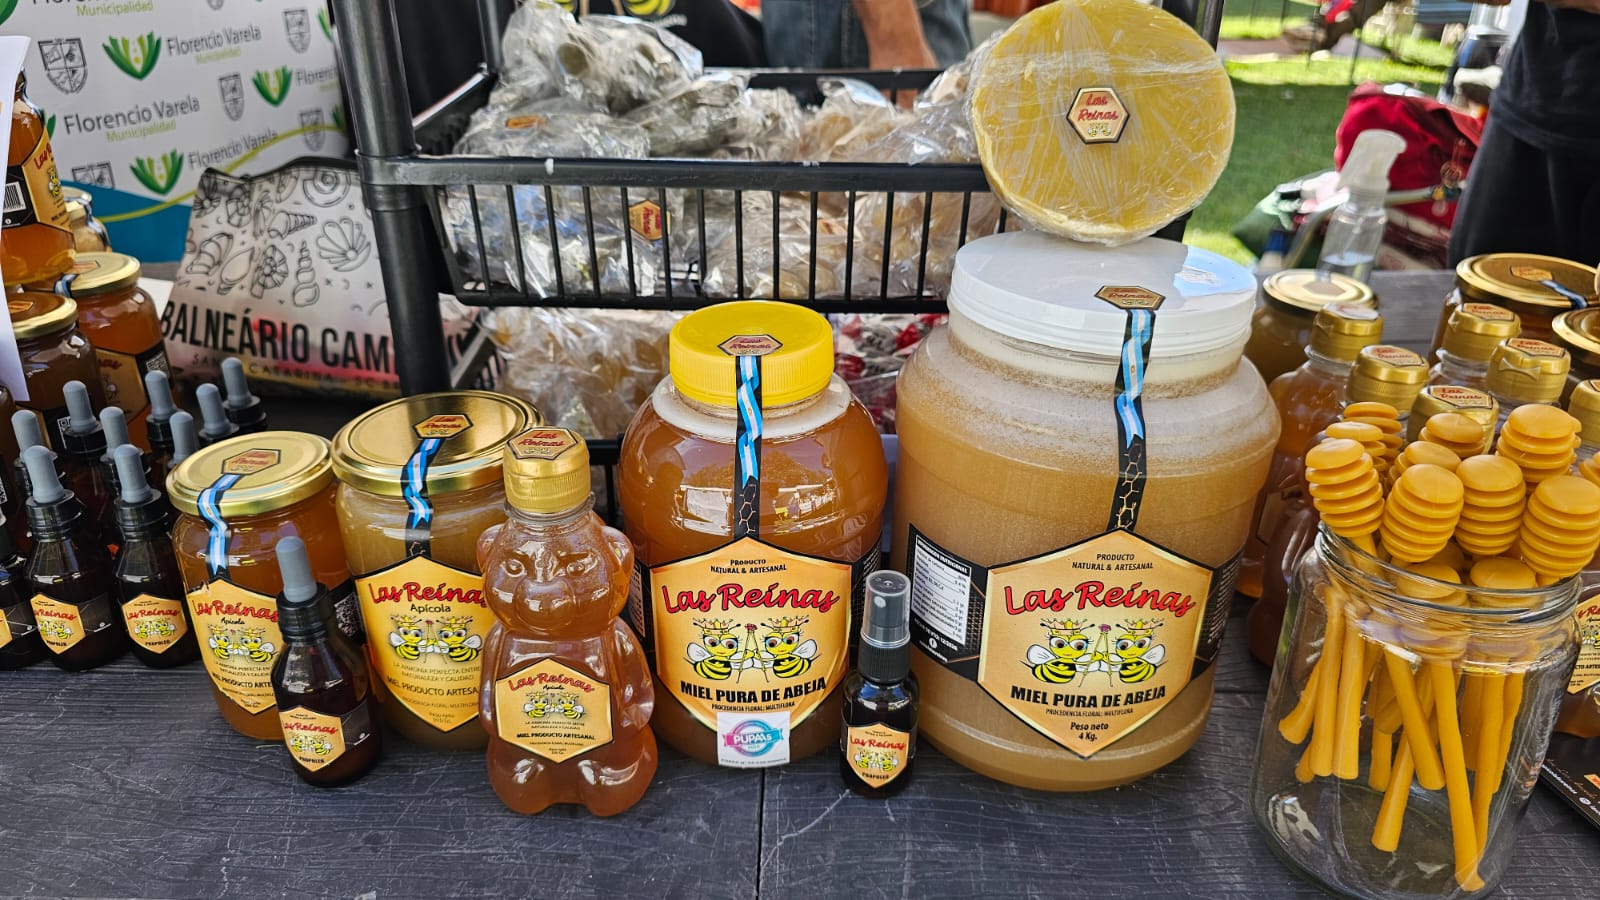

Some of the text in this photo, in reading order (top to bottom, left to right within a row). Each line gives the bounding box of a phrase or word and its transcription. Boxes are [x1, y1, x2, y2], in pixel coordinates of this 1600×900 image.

[167, 22, 261, 56] Florencio Varela
[1086, 94, 1108, 106] Las
[64, 94, 200, 134] Florencio Varela
[161, 301, 310, 364] BALNEÁRIO
[730, 559, 766, 567] PRODUCTO
[1096, 553, 1135, 561] PRODUCTO
[710, 565, 739, 574] NATURAL
[749, 563, 787, 574] ARTESANAL
[1072, 561, 1104, 571] NATURAL
[1114, 562, 1154, 571] ARTESANAL
[369, 583, 403, 604] Las
[662, 585, 717, 614] Las
[1004, 586, 1073, 615] Las
[192, 600, 213, 615] Las
[402, 682, 444, 696] PRODUCTO
[508, 676, 537, 691] Las
[680, 677, 826, 703] MIEL PURA DE ABEJA
[1011, 685, 1165, 708] MIEL PURA DE ABEJA
[1070, 722, 1108, 731] Peso neto
[850, 735, 868, 746] Las
[1085, 732, 1098, 741] Kg.
